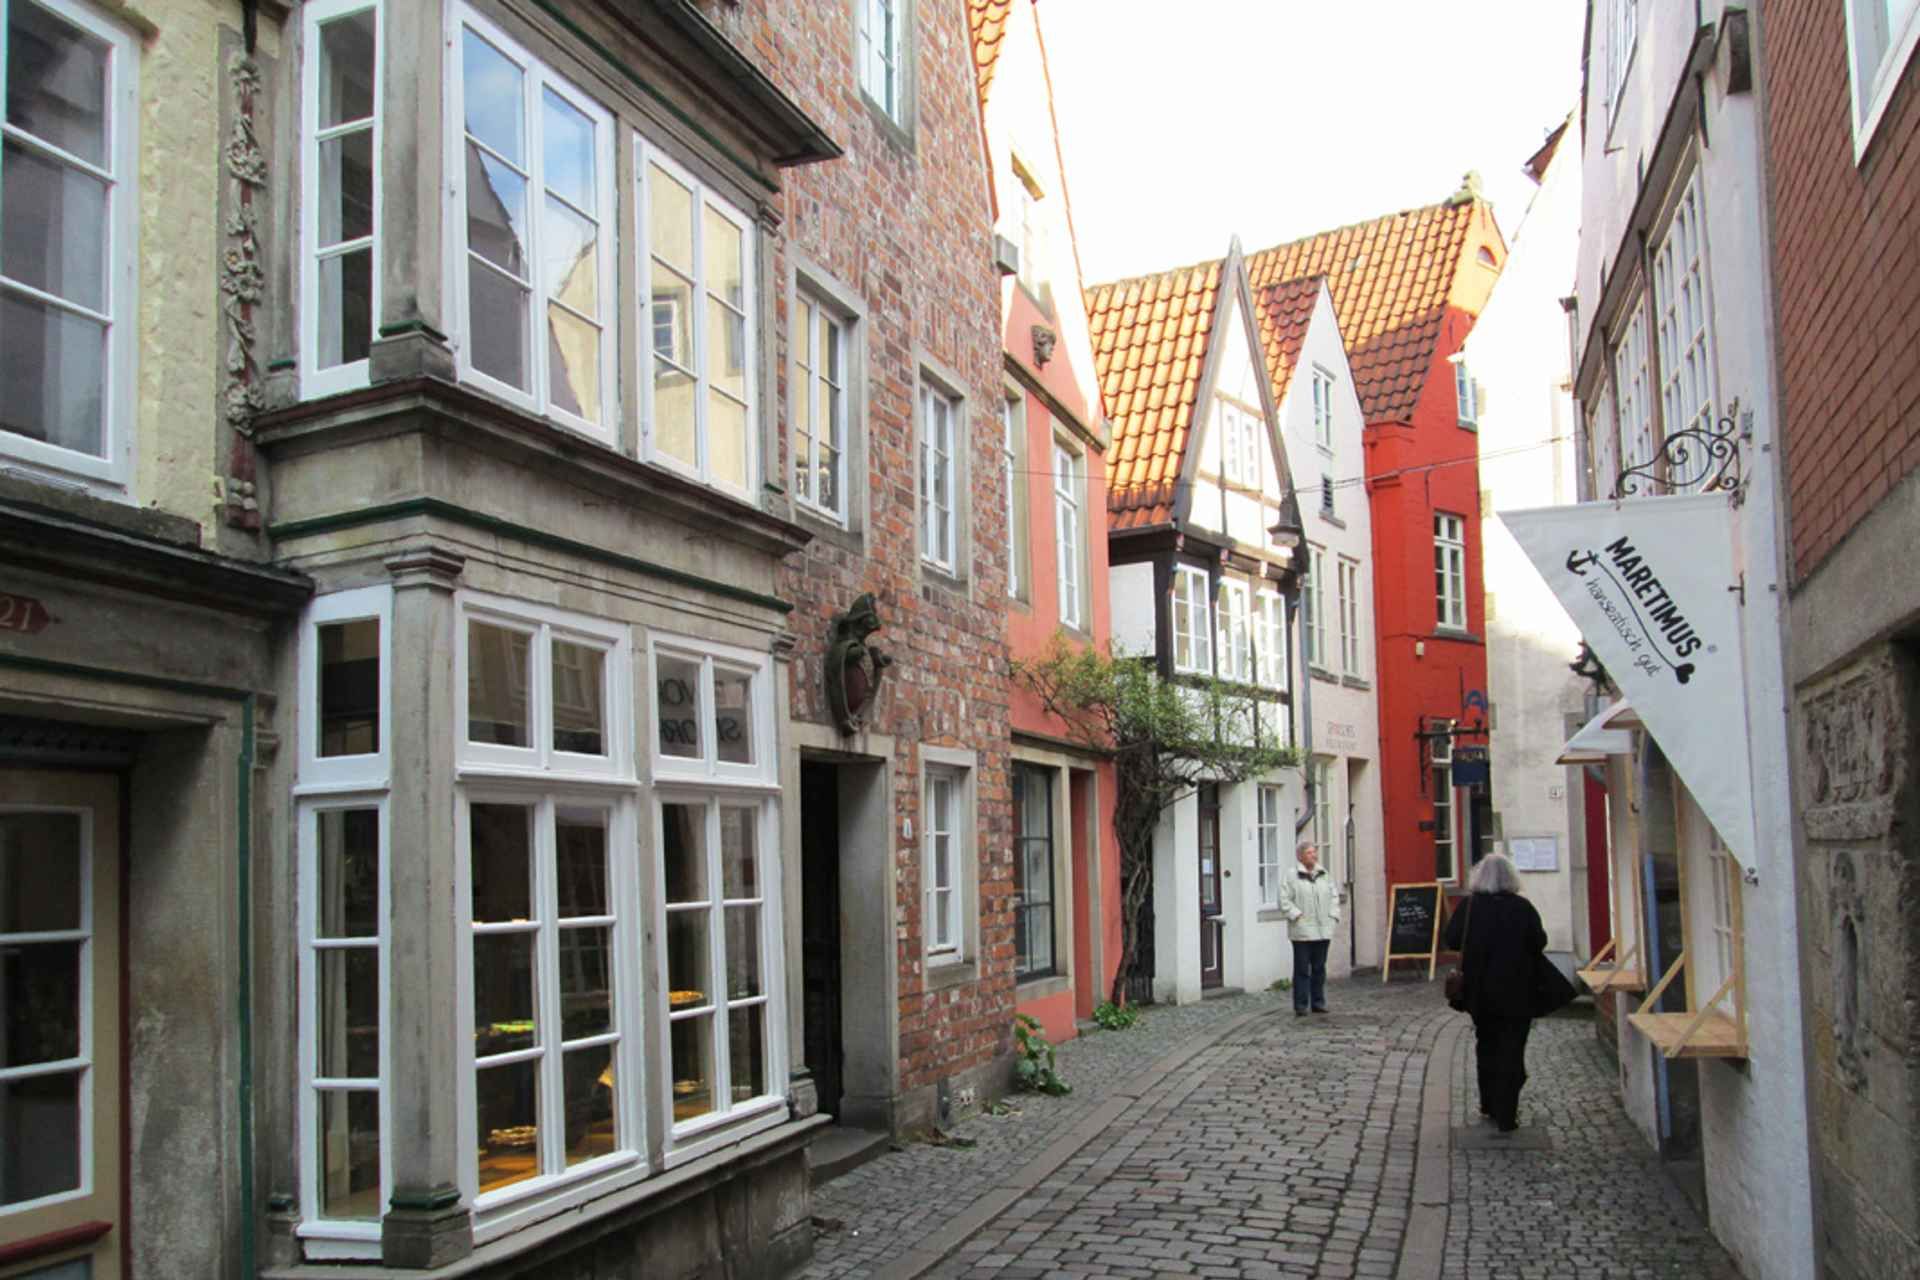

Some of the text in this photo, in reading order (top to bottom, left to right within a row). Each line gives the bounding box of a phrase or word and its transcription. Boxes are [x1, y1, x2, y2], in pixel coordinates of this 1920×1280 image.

[1585, 577, 1662, 678] hanseatisch gut
[1604, 536, 1702, 658] MARETIMUS
